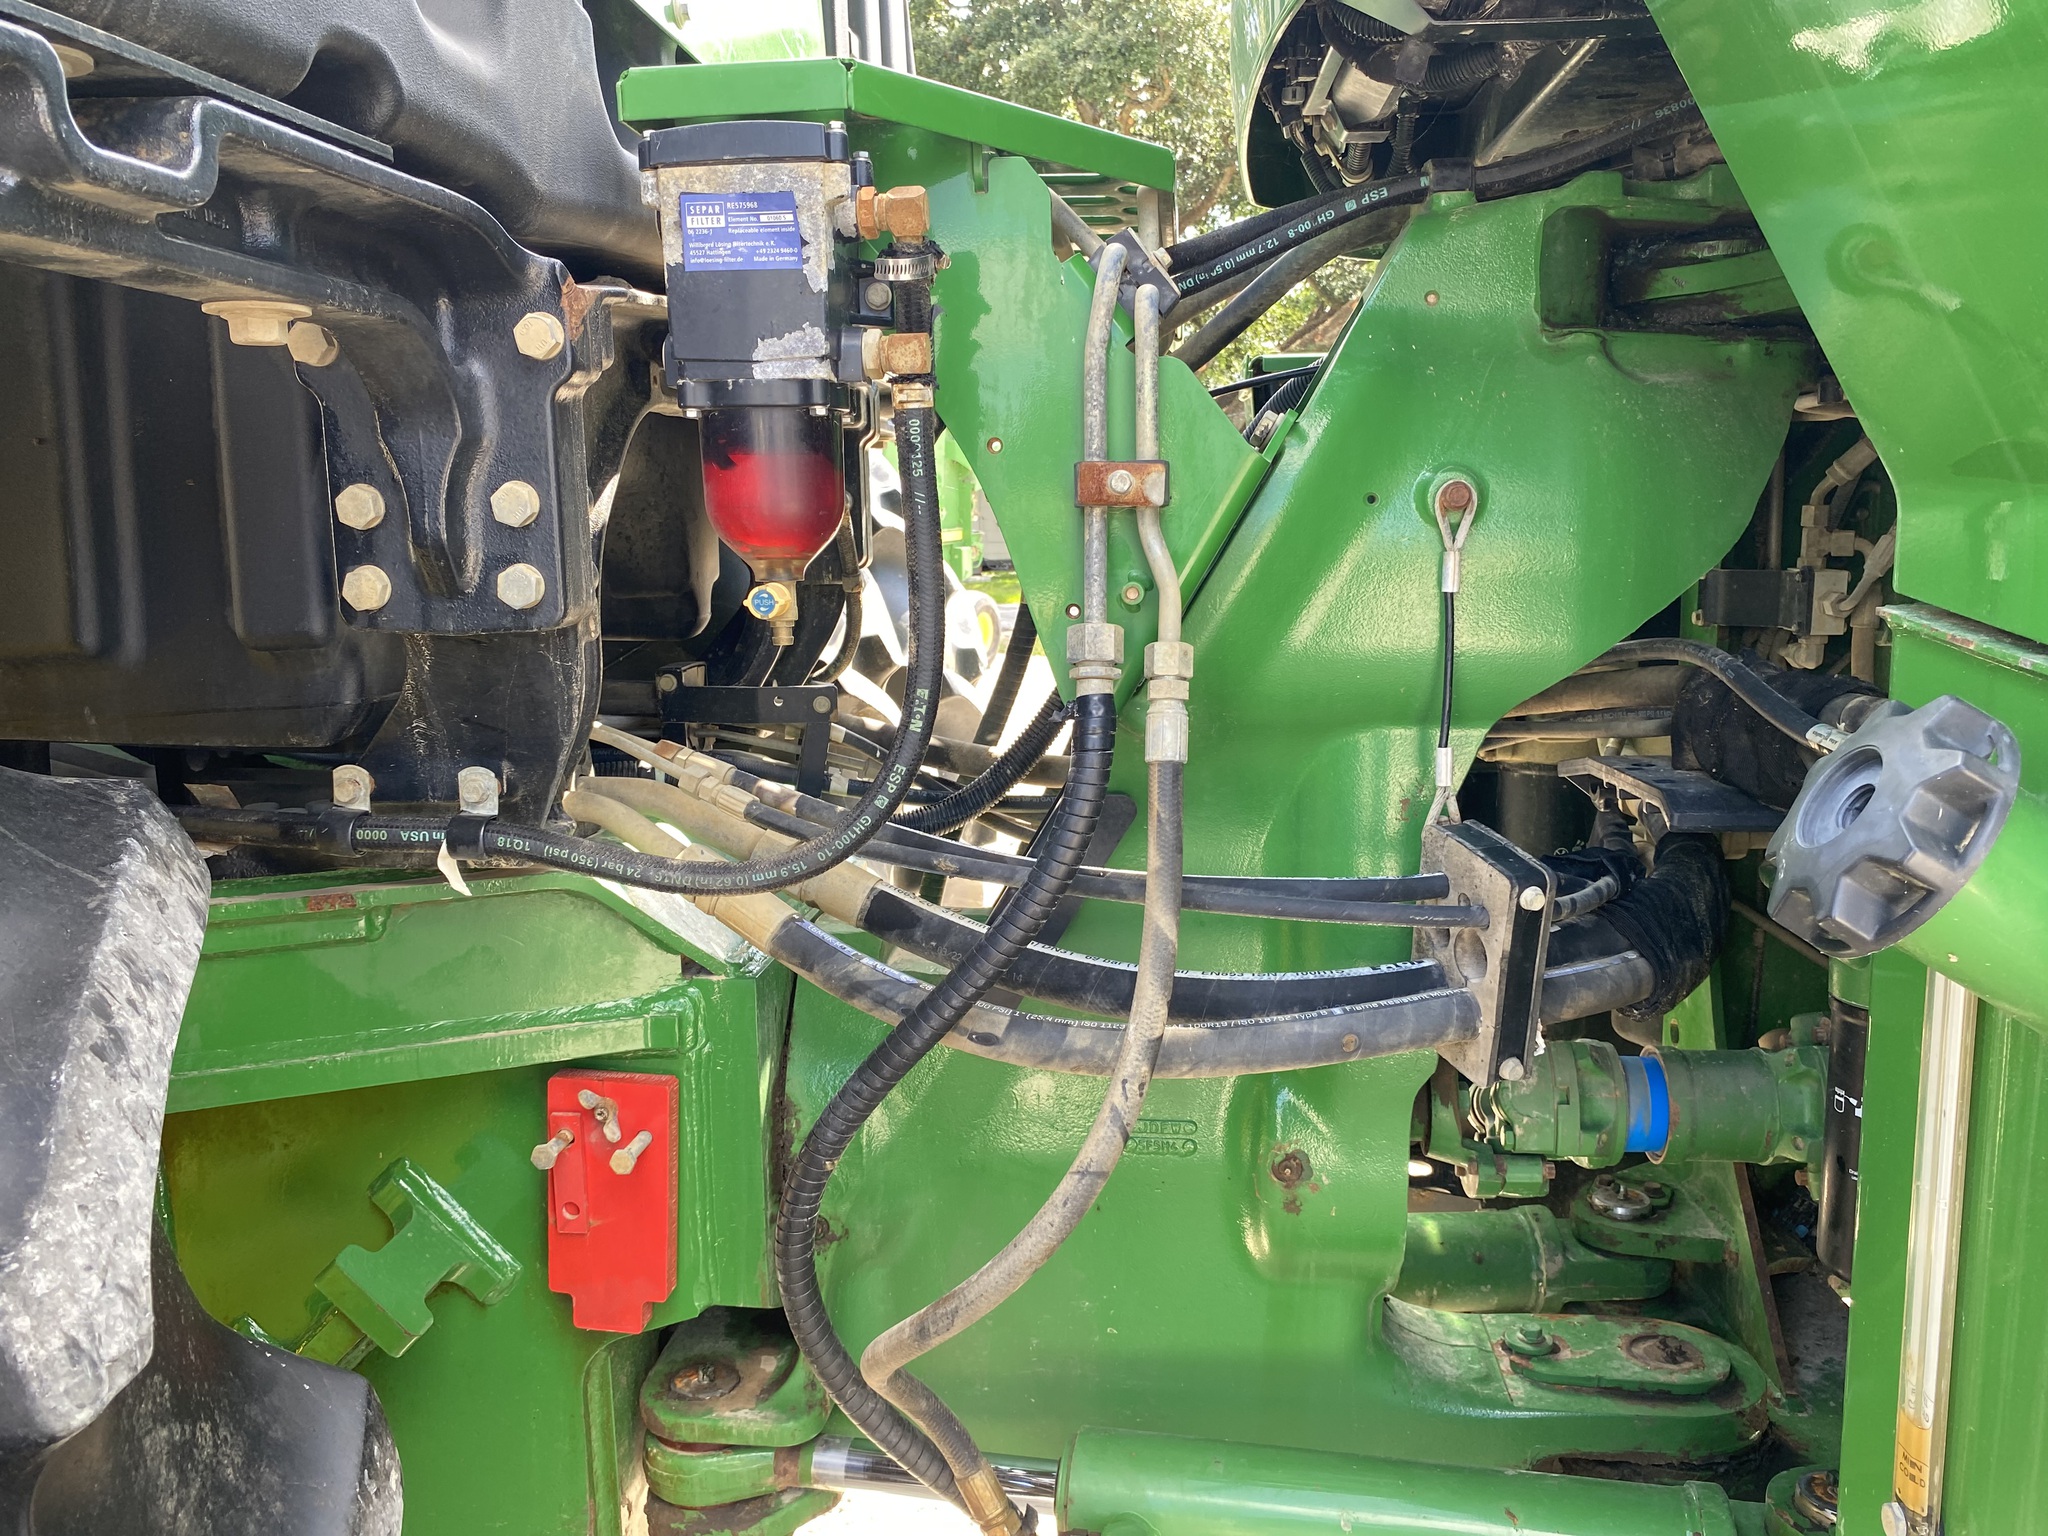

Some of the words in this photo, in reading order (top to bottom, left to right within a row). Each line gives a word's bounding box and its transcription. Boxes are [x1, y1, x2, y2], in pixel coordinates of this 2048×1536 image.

[1361, 186, 1389, 205] ESP
[689, 205, 721, 215] SEPAR
[726, 201, 759, 210] RE575968
[691, 216, 722, 226] FILTER
[1287, 209, 1335, 239] GH00-8
[1258, 237, 1280, 254] 12.7
[1236, 247, 1256, 263] mm
[886, 764, 907, 793] ESP
[356, 829, 388, 841] 0000
[400, 831, 430, 842] USA
[816, 815, 872, 862] GH100-10
[496, 836, 531, 852] 1Q18
[543, 845, 569, 858] psi)
[570, 851, 600, 869] (350
[601, 859, 624, 875] bar
[627, 867, 642, 879] 24
[752, 871, 777, 882] mm
[780, 861, 808, 878] 15.9
